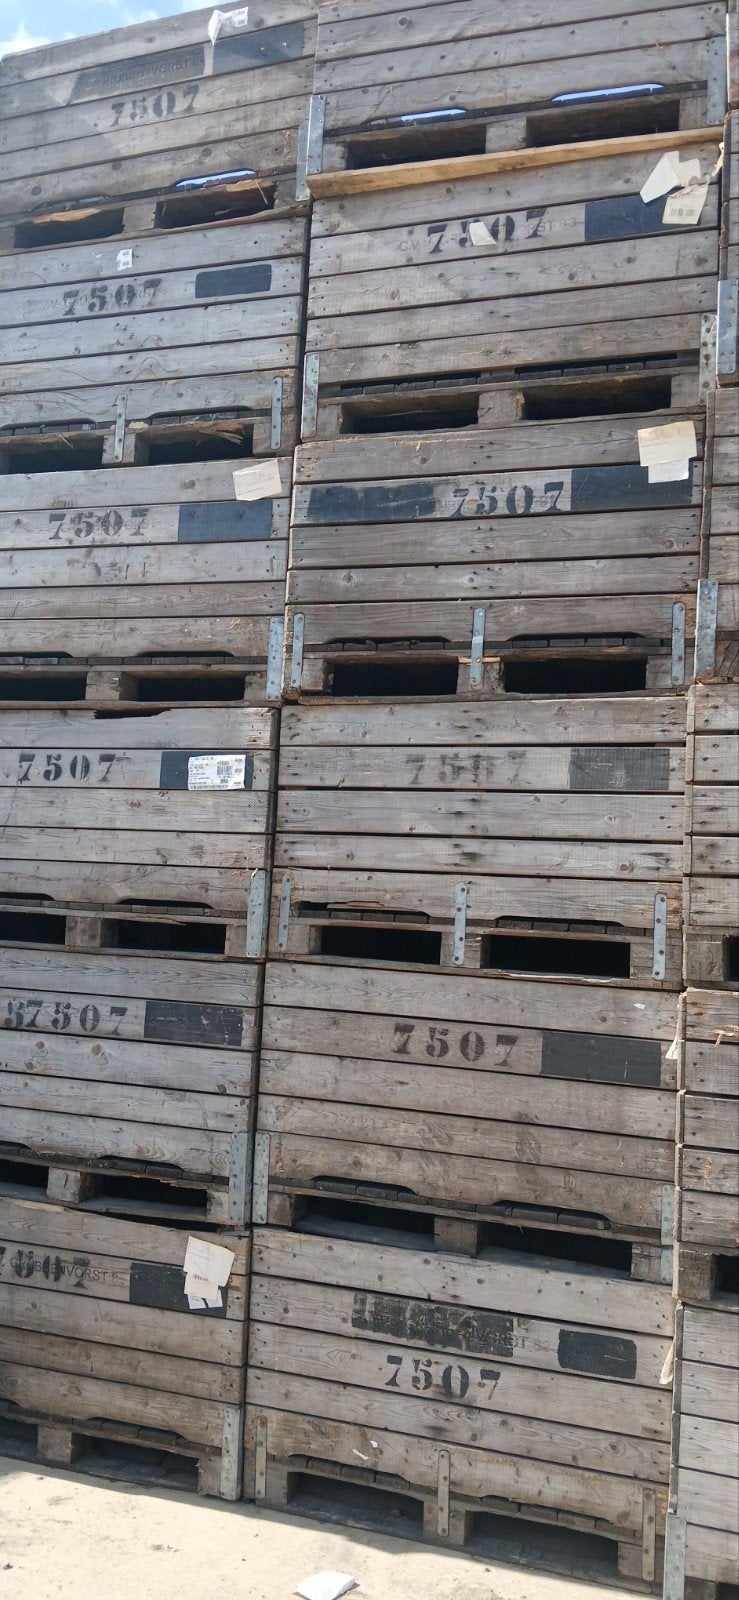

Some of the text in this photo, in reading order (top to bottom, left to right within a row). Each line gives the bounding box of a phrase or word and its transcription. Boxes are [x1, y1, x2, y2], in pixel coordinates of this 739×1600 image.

[110, 84, 200, 127] 7507
[62, 278, 161, 316] 7507
[450, 481, 564, 518] 7507
[48, 508, 149, 540] 7507
[17, 753, 116, 785] 7507
[393, 1022, 519, 1067] 7507
[385, 1354, 500, 1400] 7507
